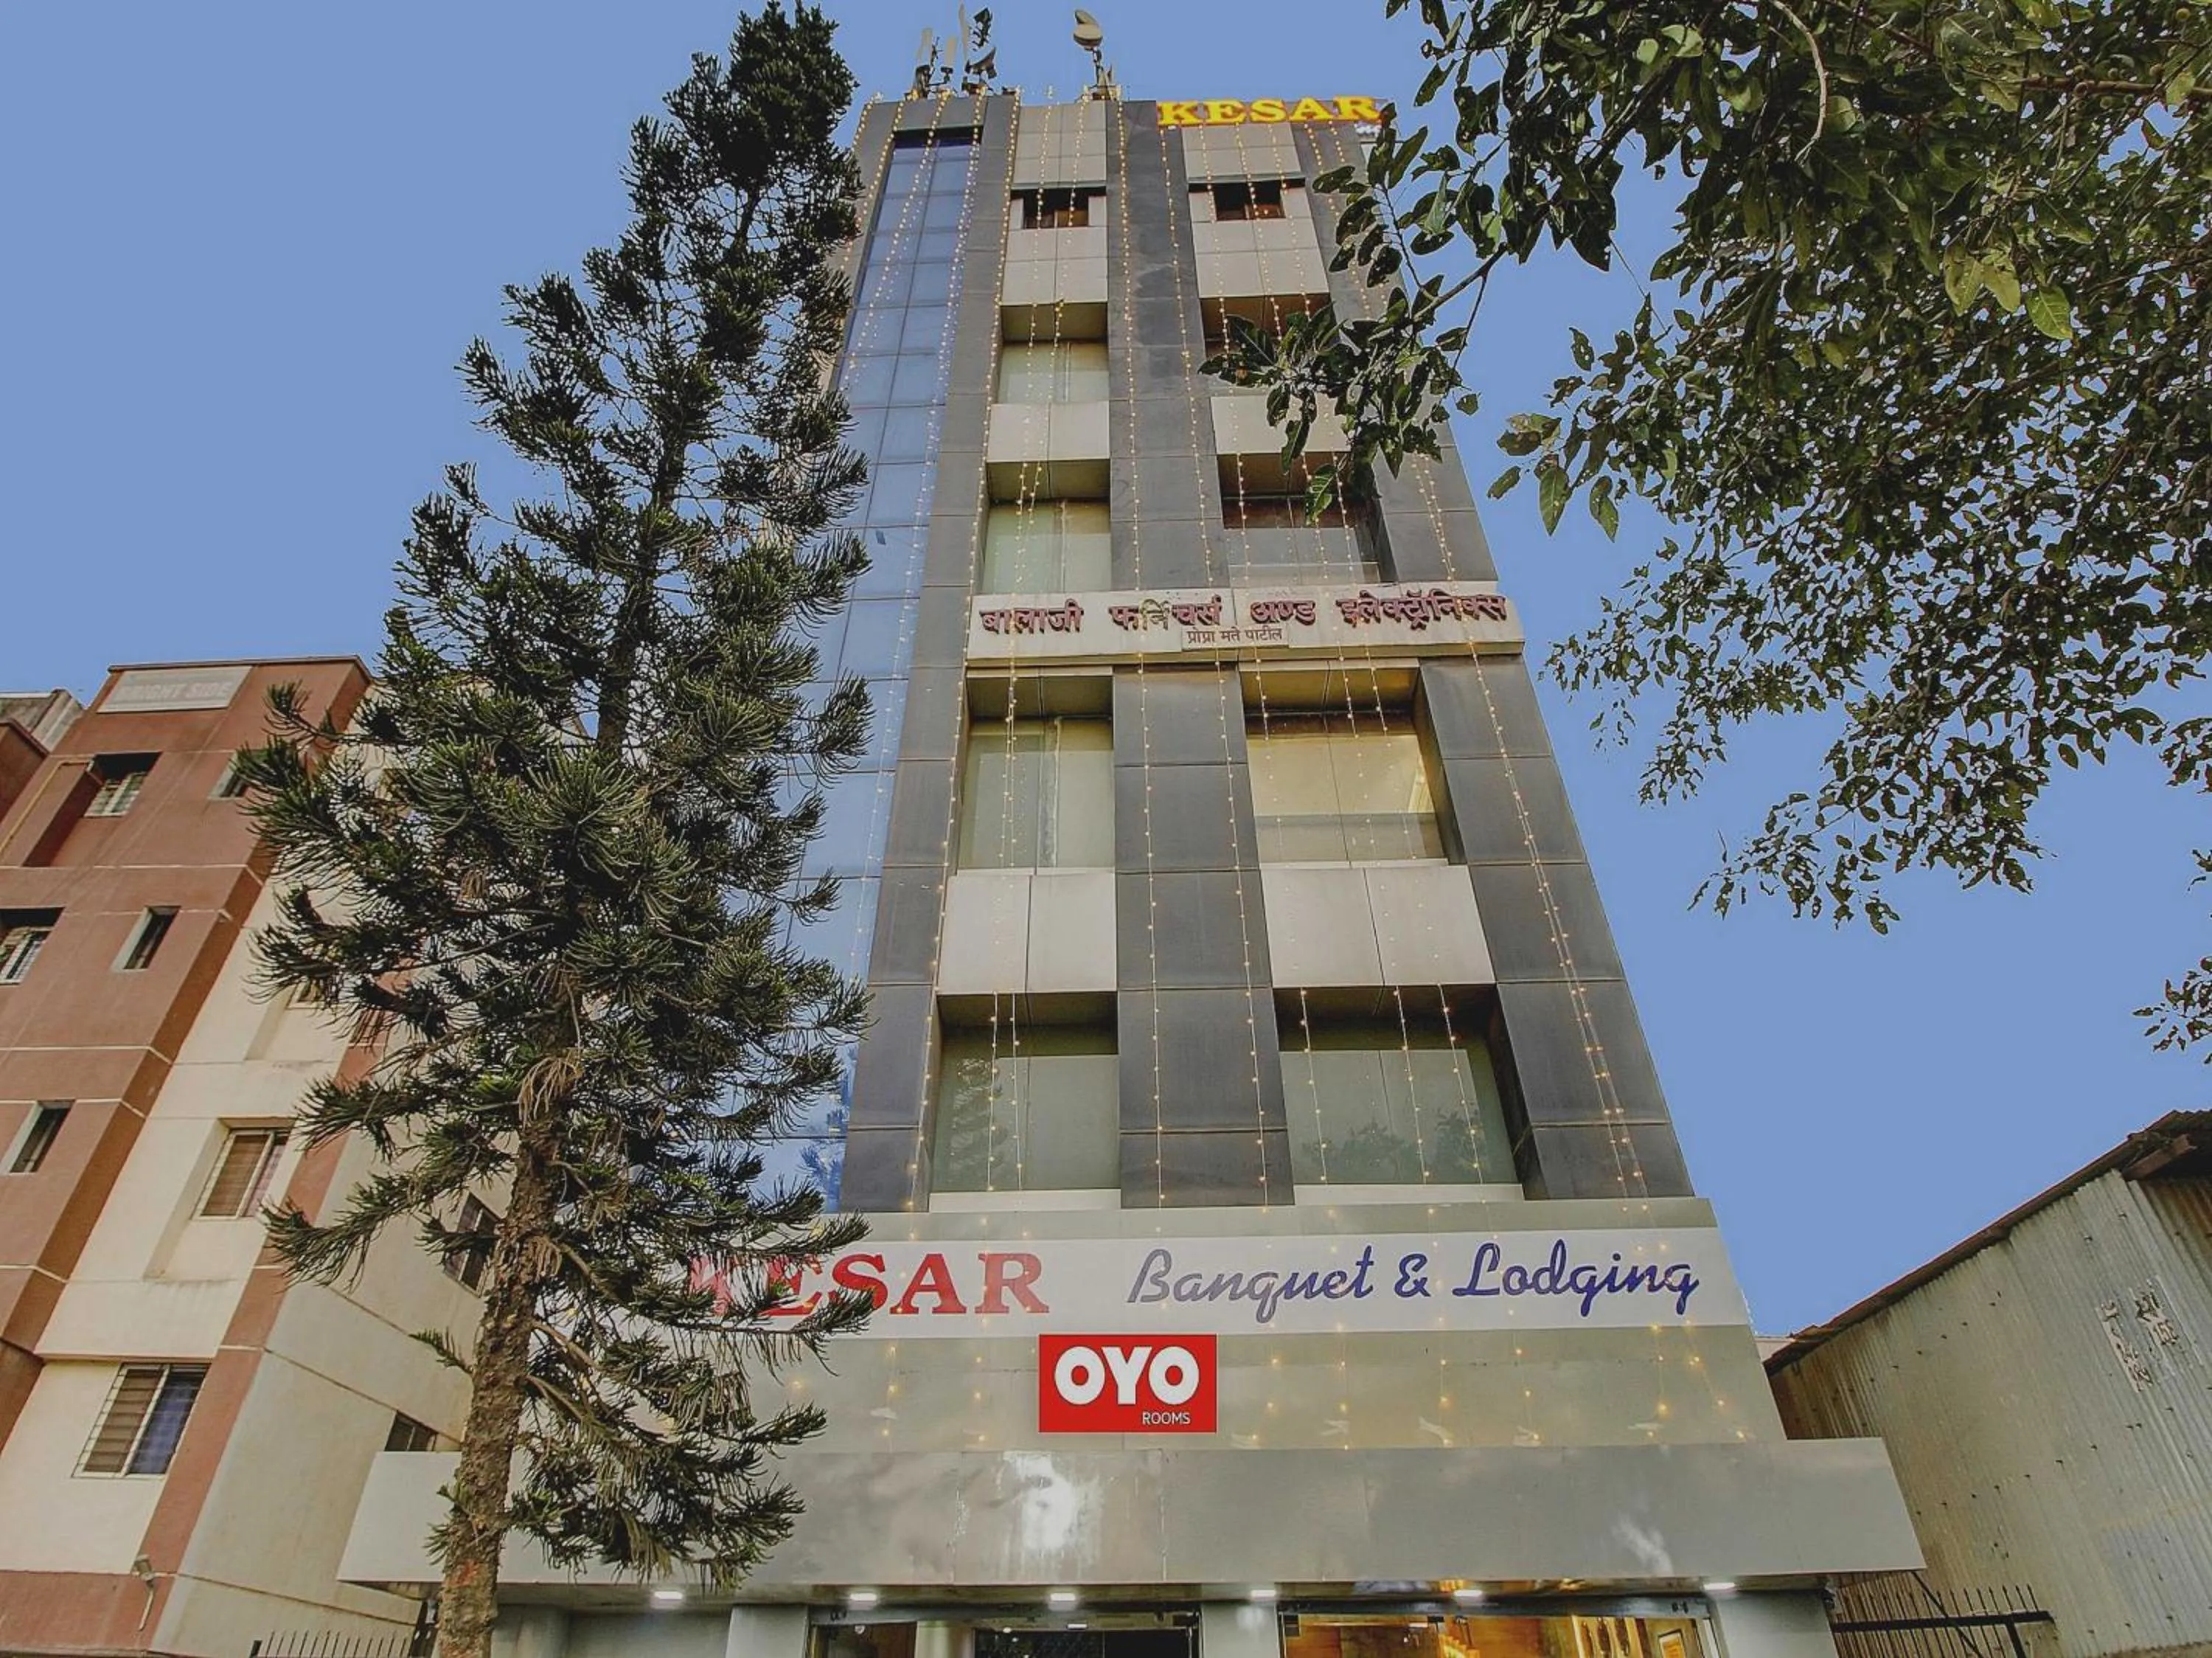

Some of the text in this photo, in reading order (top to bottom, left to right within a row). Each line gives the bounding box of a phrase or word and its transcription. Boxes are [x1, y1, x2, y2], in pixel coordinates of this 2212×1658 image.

[1157, 96, 1383, 125] KESAR
[979, 598, 1085, 634] बालाजी
[1127, 1244, 1374, 1324] Banquet
[1393, 1252, 1432, 1300] &
[1452, 1238, 1700, 1317] Lodging
[1054, 1345, 1200, 1406] OYO
[1141, 1412, 1192, 1426] ROOMS
